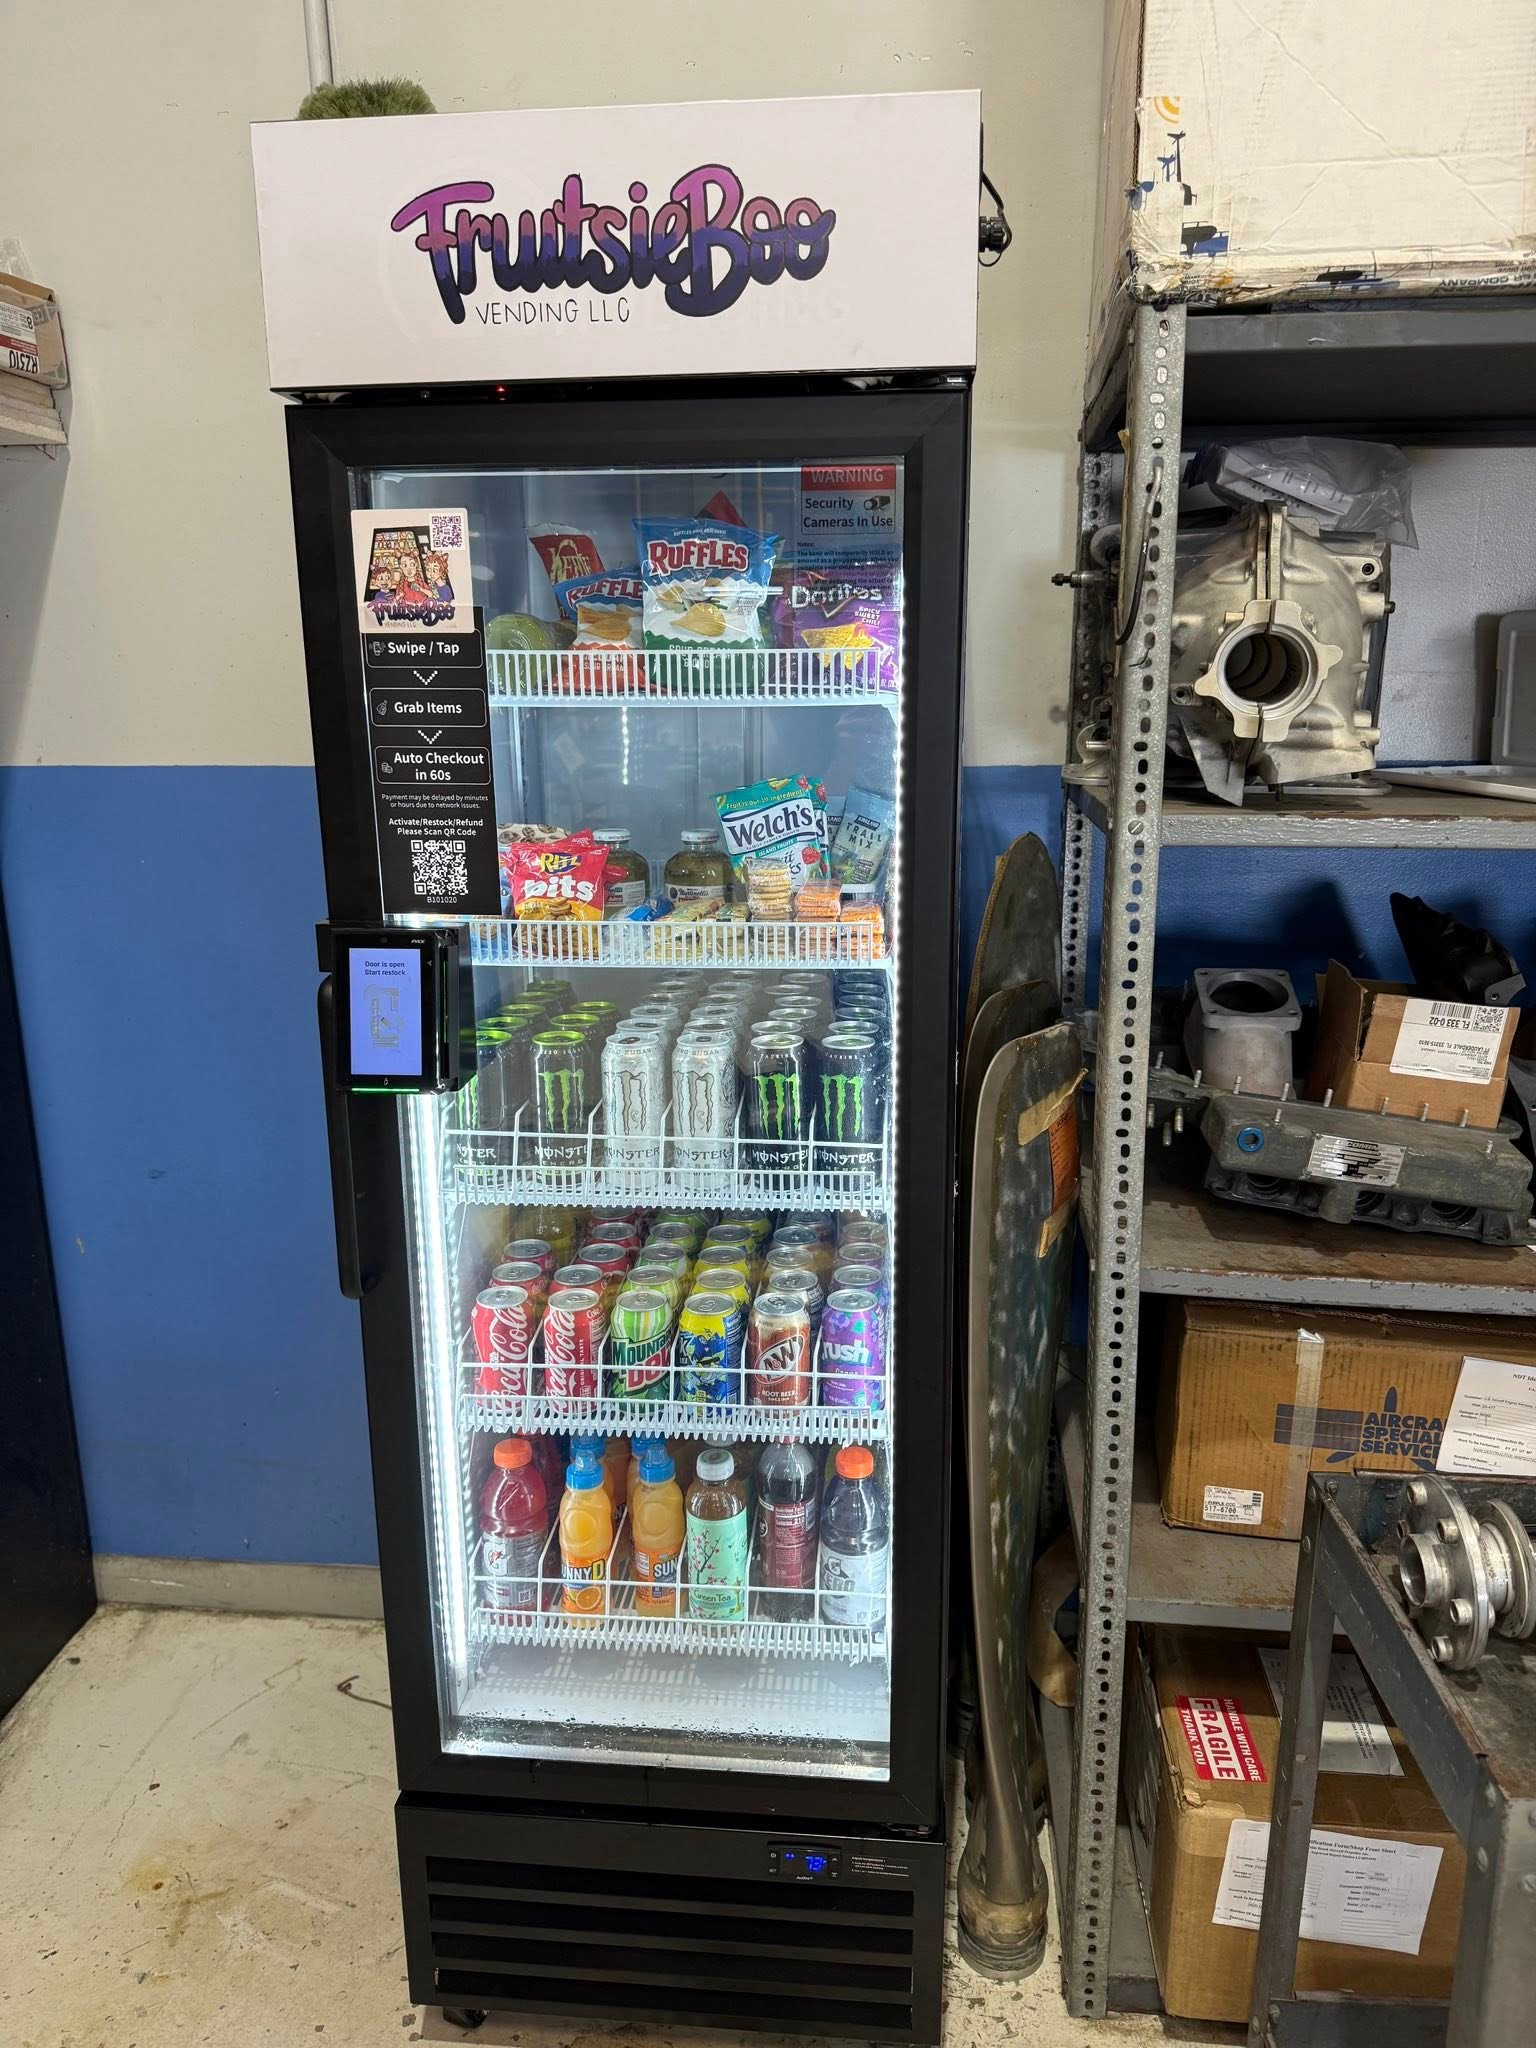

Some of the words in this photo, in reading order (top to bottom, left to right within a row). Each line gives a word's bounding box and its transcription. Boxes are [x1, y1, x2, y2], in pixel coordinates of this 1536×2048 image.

[1439, 276, 1509, 287] COMPANY
[476, 299, 578, 325] VENDING
[589, 297, 630, 323] LLC
[812, 468, 884, 483] WARNING
[805, 497, 853, 511] Security
[803, 516, 854, 528] Cameras
[857, 516, 868, 527] In
[871, 515, 893, 527] Use
[648, 538, 749, 577] RUFFLES
[567, 578, 643, 608] RUFFLE
[791, 584, 883, 608] Doritos
[854, 611, 881, 620] SWEET
[859, 606, 881, 614] SPICY
[861, 618, 881, 627] CHILI
[388, 641, 426, 656] Swipe
[429, 641, 434, 656] /
[436, 642, 460, 656] Tap
[394, 701, 424, 714] Grab
[427, 702, 462, 714] Items
[394, 752, 423, 764] Auto
[425, 752, 485, 764] Checkout
[415, 769, 429, 781] in
[430, 769, 452, 781] 60s
[381, 793, 408, 801] Payment
[422, 793, 430, 801] be
[455, 794, 464, 802] by
[388, 817, 484, 827] Activate/Restock/Refund
[727, 804, 814, 849] Welch's
[397, 828, 423, 836] Please
[423, 828, 443, 836] Scan
[443, 828, 456, 837] QR
[456, 828, 477, 836] Code
[845, 821, 883, 843] TRAIL
[758, 846, 776, 857] ISLAND
[776, 839, 795, 851] FRUITS
[848, 834, 874, 850] MIX
[540, 852, 582, 873] RITZ
[525, 875, 594, 902] bits
[1446, 1019, 1459, 1028] 333
[624, 1048, 651, 1056] SUGAR
[457, 1143, 497, 1159] NSTER
[534, 1144, 589, 1160] MONSTE
[752, 1148, 805, 1164] MONSTE
[541, 1157, 584, 1166] ENERG
[762, 1338, 798, 1382] A&W
[822, 1339, 870, 1365] rush
[1364, 1412, 1446, 1434] AIRCRA
[1362, 1425, 1443, 1445] SPECIAL
[561, 1558, 605, 1580] UNNYD
[653, 1556, 679, 1577] SUN
[824, 1575, 856, 1593] ERO
[694, 1587, 716, 1602] Green
[716, 1594, 732, 1602] Tea
[1180, 1708, 1199, 1742] THANK
[1192, 1744, 1207, 1766] YOU
[1194, 1699, 1239, 1778] FRAGILE
[1223, 1698, 1244, 1732] HANDLE
[1235, 1733, 1253, 1756] WITH
[1244, 1757, 1262, 1782] CARE
